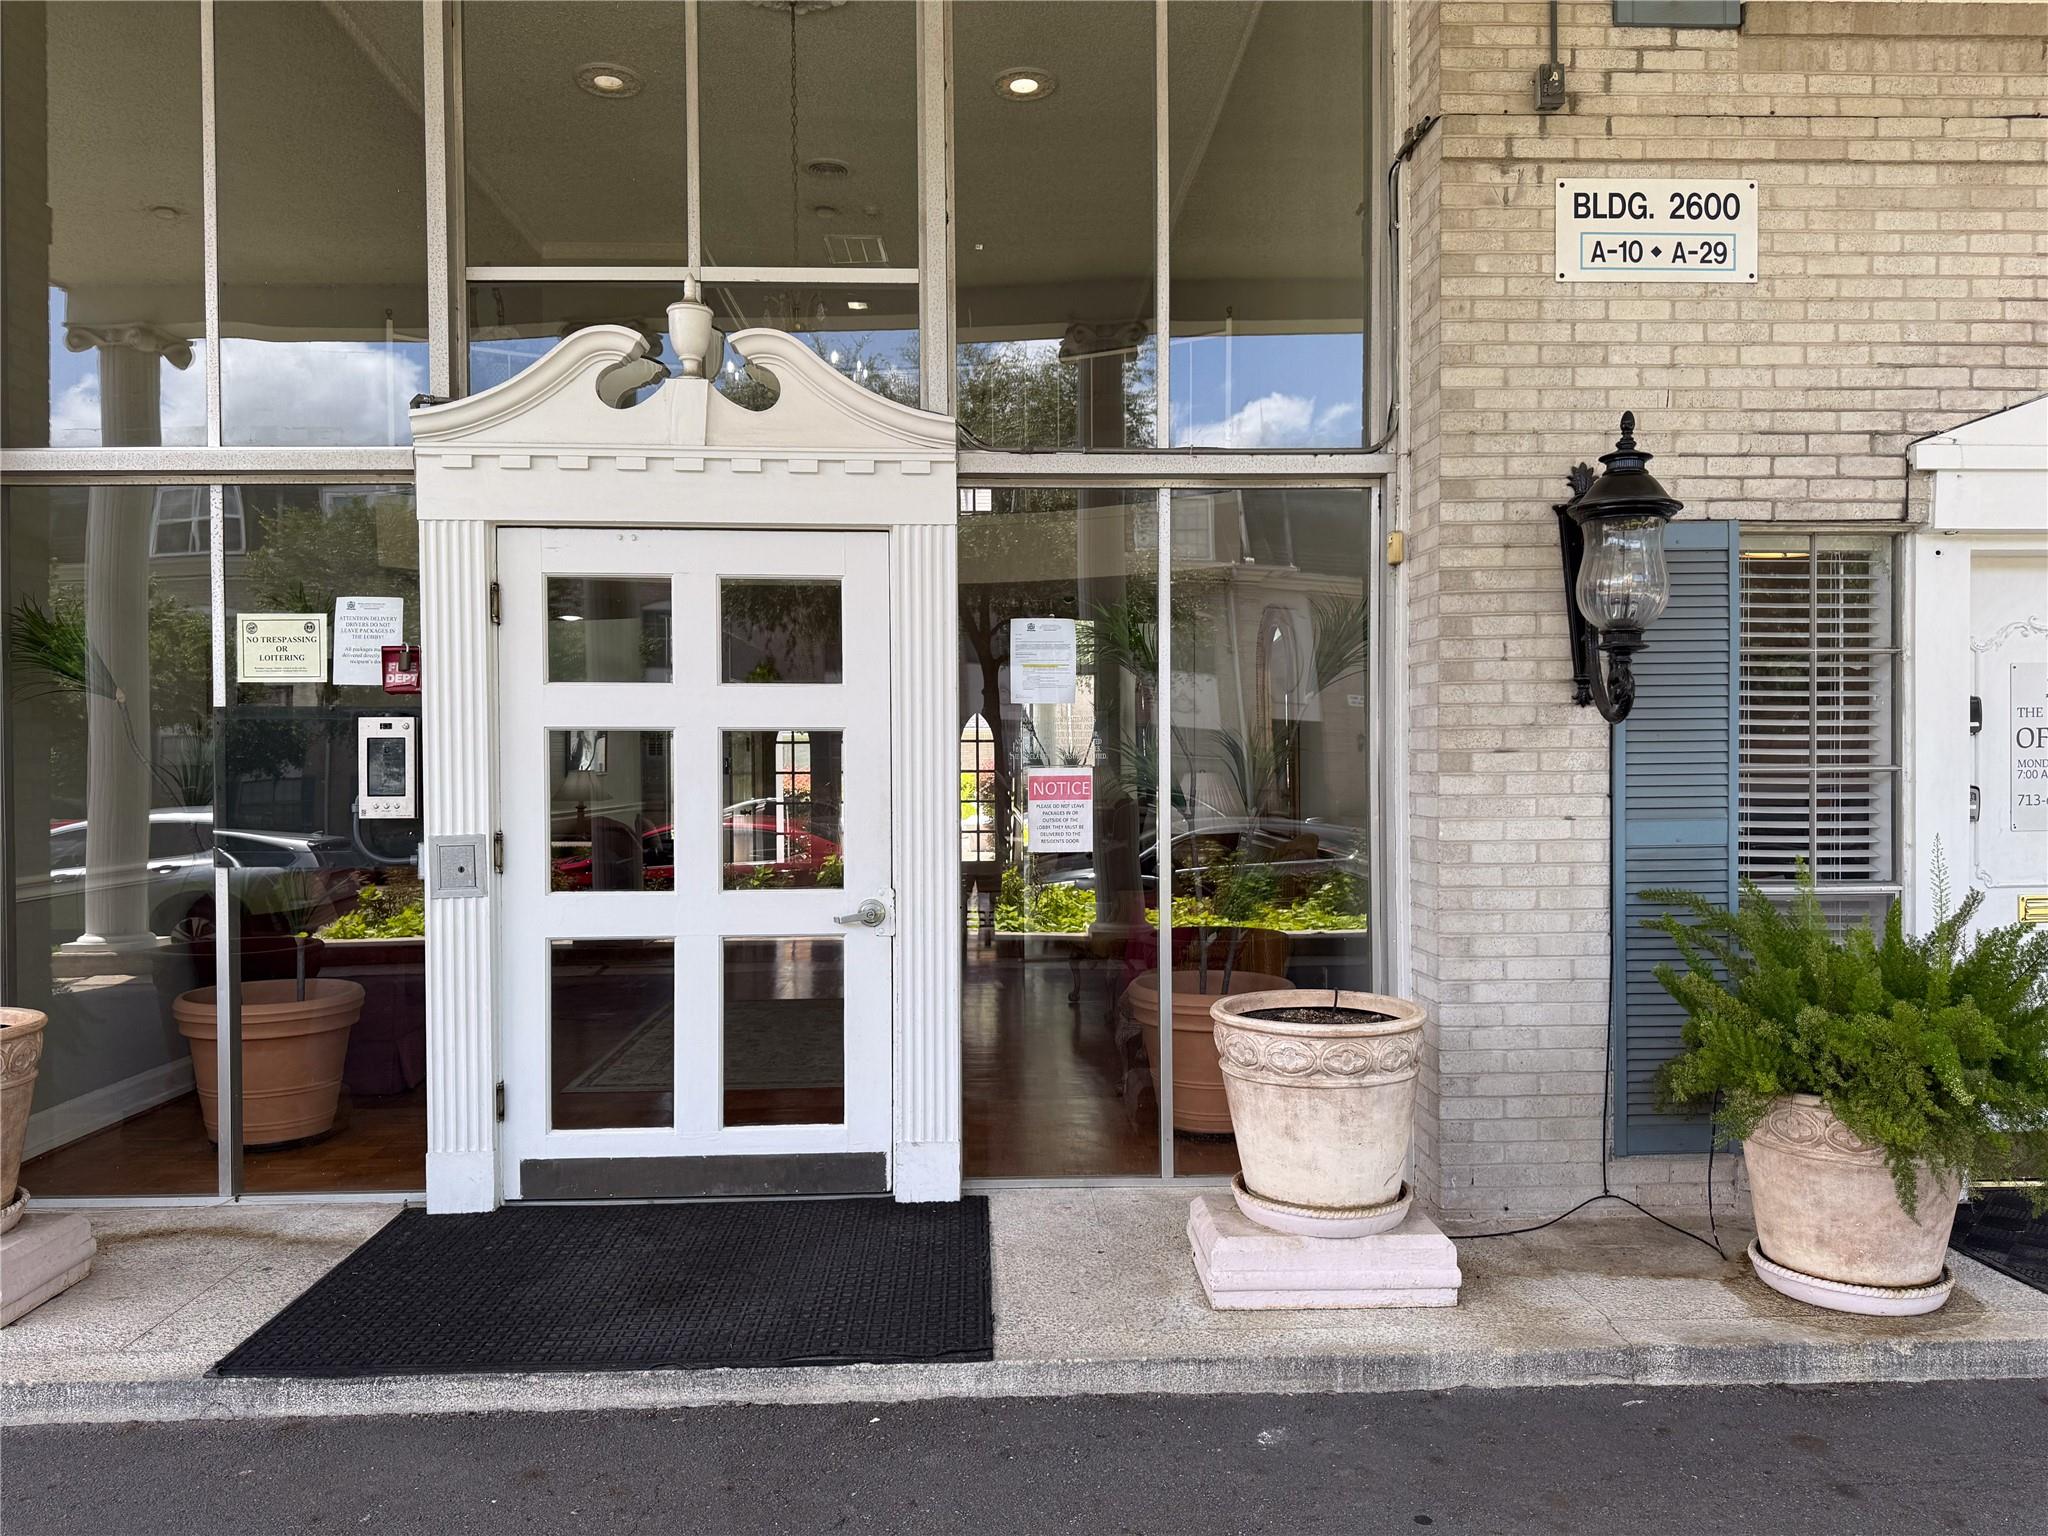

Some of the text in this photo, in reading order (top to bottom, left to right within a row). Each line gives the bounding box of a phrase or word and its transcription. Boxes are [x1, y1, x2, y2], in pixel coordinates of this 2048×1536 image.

[1573, 192, 1741, 220] BLDG. 2600
[1590, 240, 1728, 264] A-10 A-29
[259, 654, 305, 662] LOITERING
[388, 662, 417, 672] FIE
[386, 673, 419, 683] DEPT
[2016, 707, 2044, 718] THE
[2017, 769, 2039, 779] 7:00
[1033, 781, 1090, 796] NOTICE
[2017, 794, 2048, 806] 713-
